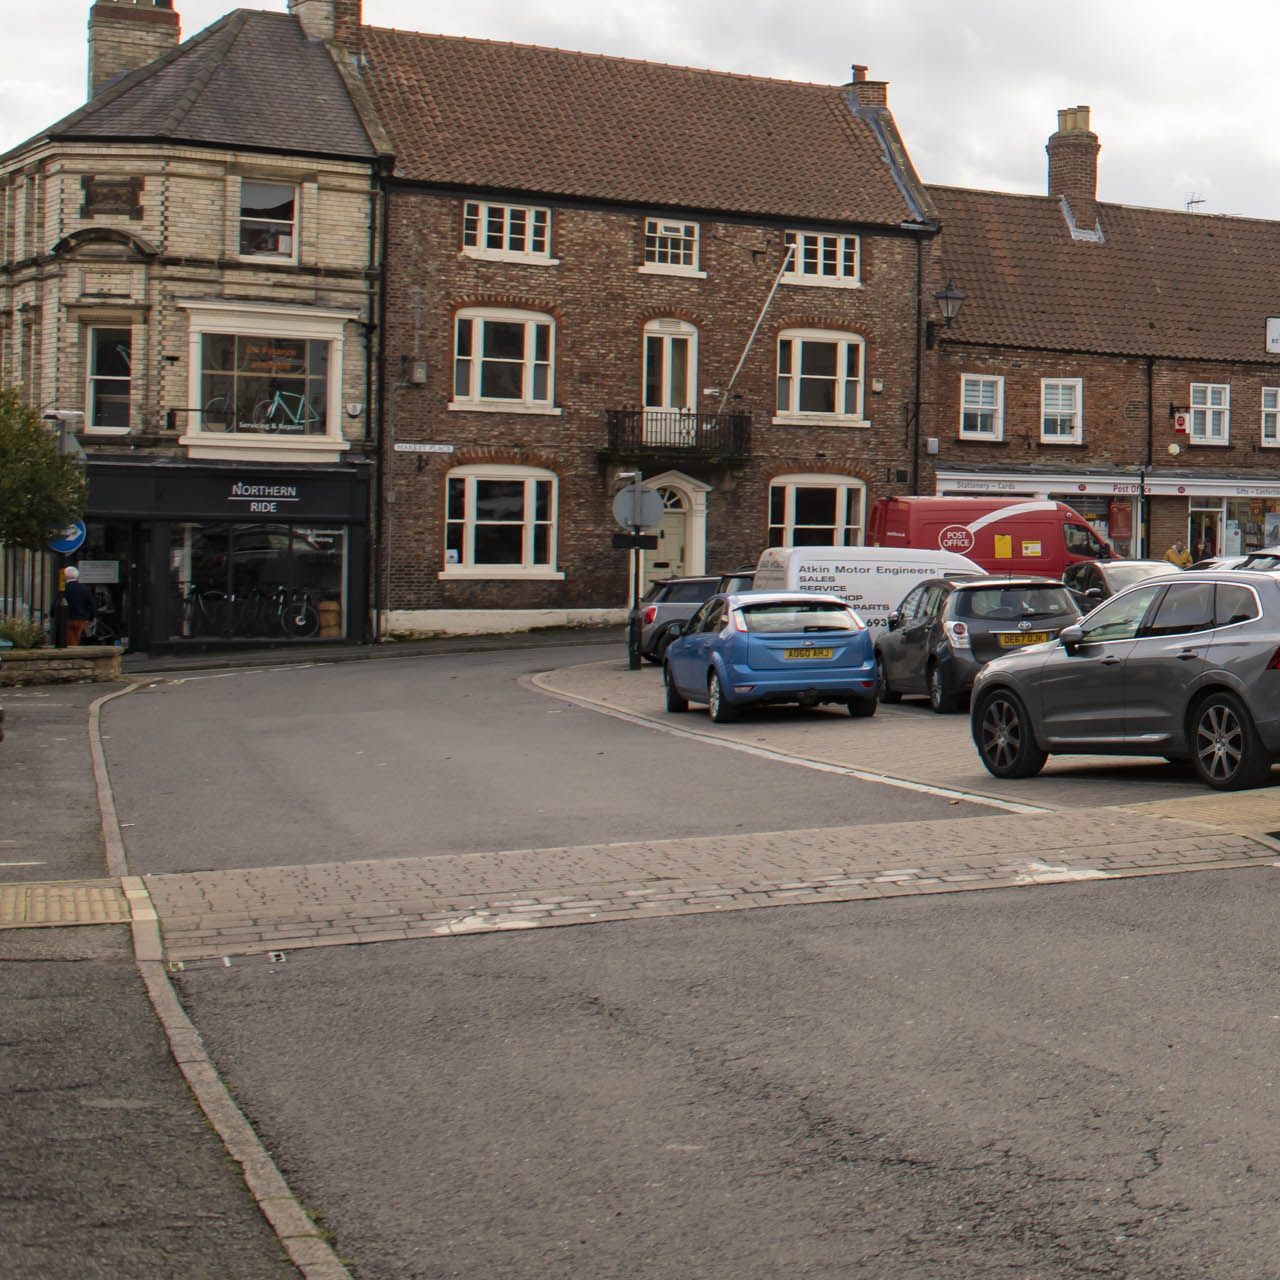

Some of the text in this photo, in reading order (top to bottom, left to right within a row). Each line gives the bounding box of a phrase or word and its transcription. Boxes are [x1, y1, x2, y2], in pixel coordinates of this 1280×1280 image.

[231, 482, 297, 496] NORTHERN
[956, 481, 990, 490] Stationery
[997, 482, 1016, 490] Cards
[1112, 484, 1152, 494] Post Ofce
[1235, 487, 1249, 496] Gifts
[250, 502, 278, 513] RIDE
[947, 531, 967, 540] POST
[942, 538, 970, 548] OFFICE
[799, 565, 936, 576] Atkin Motor Engineers
[839, 594, 864, 602] HOP
[853, 603, 890, 611] PARTS
